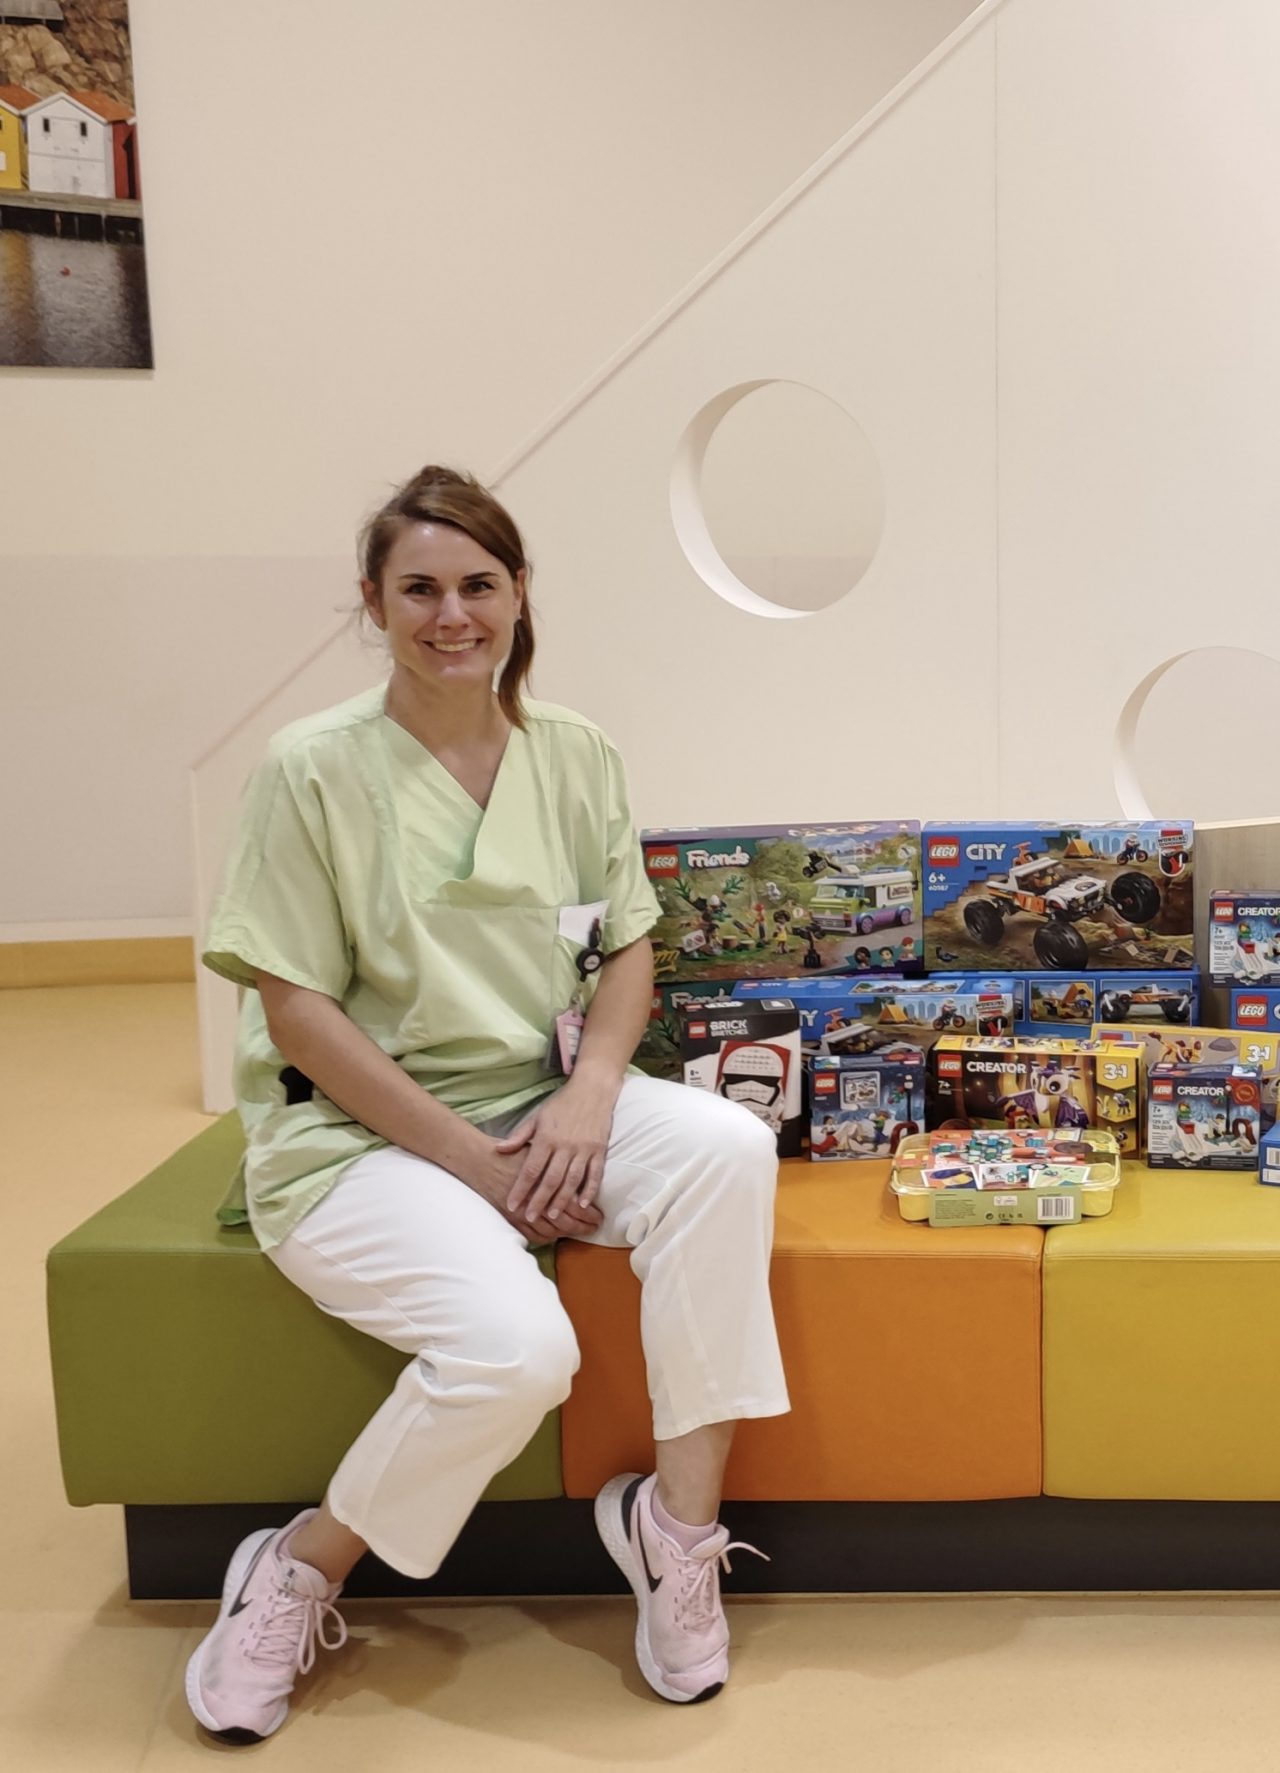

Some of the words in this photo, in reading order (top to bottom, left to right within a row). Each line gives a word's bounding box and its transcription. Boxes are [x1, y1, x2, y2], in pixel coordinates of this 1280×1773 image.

[649, 855, 678, 868] LEGO
[686, 845, 751, 868] Friends
[931, 846, 958, 858] LEGO
[928, 872, 947, 884] 6+
[1239, 1004, 1266, 1016] LEGO
[799, 1009, 819, 1027] TY
[709, 1019, 748, 1031] BRICK
[966, 1061, 1027, 1074] CREATOR
[1176, 1085, 1225, 1096] CREATOR
